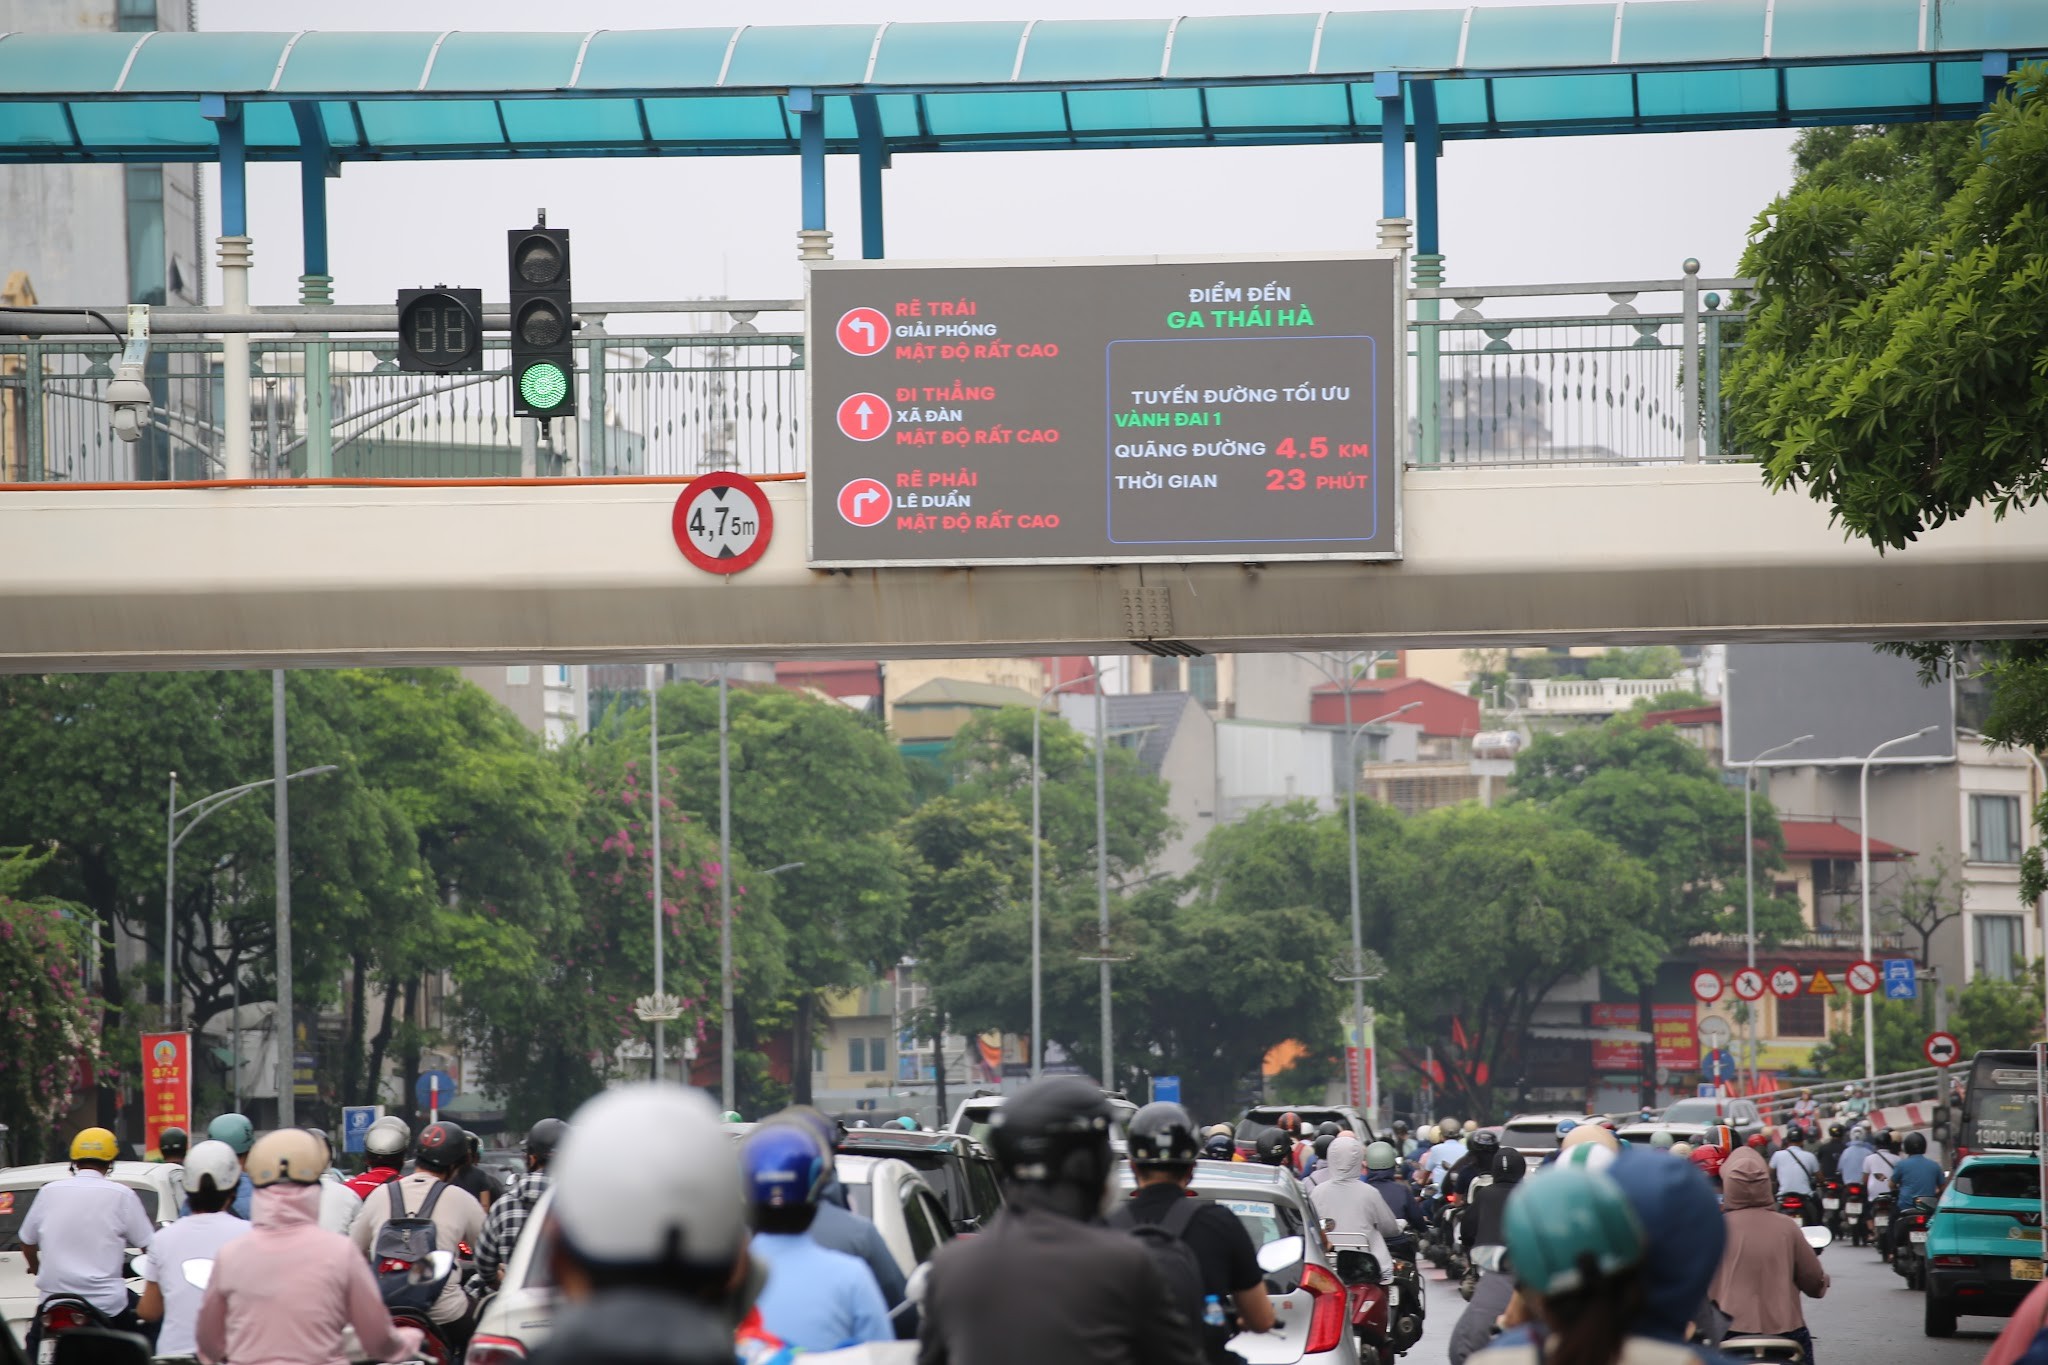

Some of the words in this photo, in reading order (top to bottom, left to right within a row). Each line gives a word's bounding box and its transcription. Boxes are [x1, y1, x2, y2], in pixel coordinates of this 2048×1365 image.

[1189, 281, 1241, 302] ĐIỂM
[1247, 281, 1290, 301] ĐẾN
[896, 299, 921, 316] RẼ
[928, 298, 976, 316] TRÁI
[1167, 311, 1204, 329] GA
[1211, 305, 1271, 328] THÁI
[1278, 304, 1314, 326] HÀ
[896, 321, 931, 337] GIẢI
[935, 321, 997, 336] PHÓNG
[896, 342, 936, 362] MẬT
[941, 342, 970, 362] ĐỘ
[974, 339, 1012, 358] RẤT
[1016, 344, 1059, 358] CAO
[896, 388, 917, 402] ĐI
[923, 379, 995, 401] THẲNG
[1131, 384, 1198, 404] TUYẾN
[1203, 385, 1277, 403] ĐƯỜNG
[1282, 382, 1316, 401] TỐI
[1322, 386, 1349, 400] ƯU
[897, 407, 922, 422] XÃ
[925, 407, 962, 422] ĐÀN
[1115, 410, 1169, 427] VÀNH
[1174, 412, 1208, 426] ĐAI
[1213, 412, 1220, 425] 1
[896, 428, 937, 447] MẬT
[941, 427, 971, 447] ĐỘ
[975, 424, 1013, 443] RẤT
[1017, 429, 1059, 443] CAO
[1115, 441, 1187, 458] QUÃNG
[1192, 439, 1266, 456] ĐƯỜNG
[1276, 437, 1328, 458] 4.5
[1339, 444, 1368, 457] KM
[897, 470, 923, 487] RẼ
[928, 468, 977, 486] PHẢI
[1115, 471, 1162, 489] THỜI
[1168, 474, 1217, 488] GIAN
[1266, 469, 1306, 490] 23
[1316, 472, 1368, 489] PHÚT
[897, 493, 918, 508] LÊ
[922, 490, 970, 507] DUẨN
[689, 507, 755, 542] 4,75m
[897, 513, 937, 533] MẬT
[942, 512, 971, 532] ĐỘ
[975, 510, 1013, 528] RẤT
[1017, 515, 1060, 528] CAO
